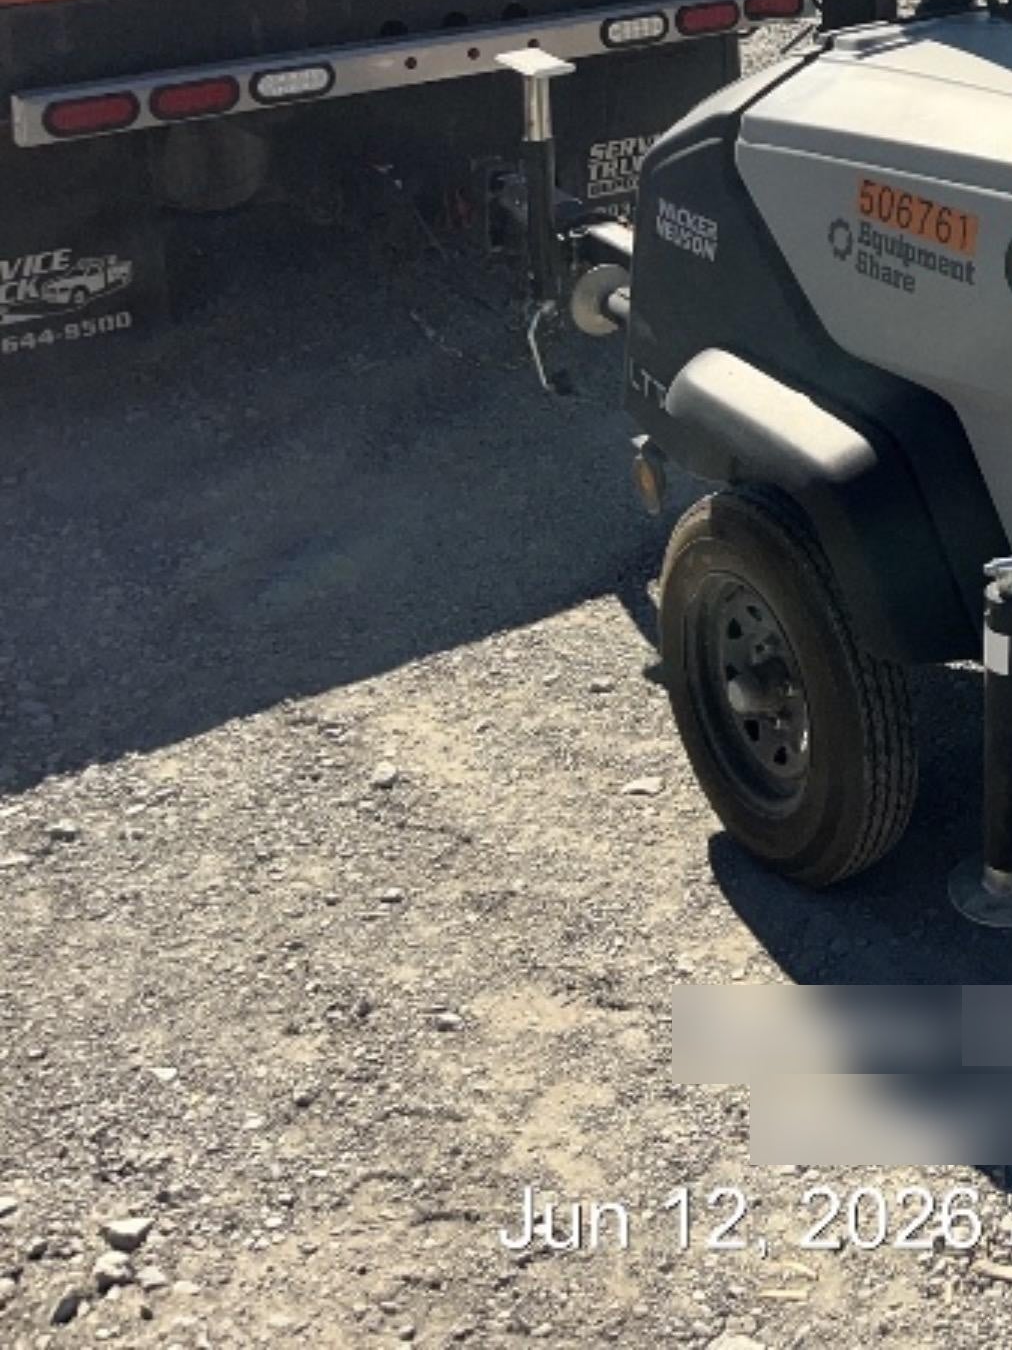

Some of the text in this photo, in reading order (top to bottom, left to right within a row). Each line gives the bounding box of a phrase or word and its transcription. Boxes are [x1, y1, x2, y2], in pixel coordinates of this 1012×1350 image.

[860, 178, 969, 250] 506761
[856, 251, 917, 293] Share
[857, 221, 976, 285] Equipment
